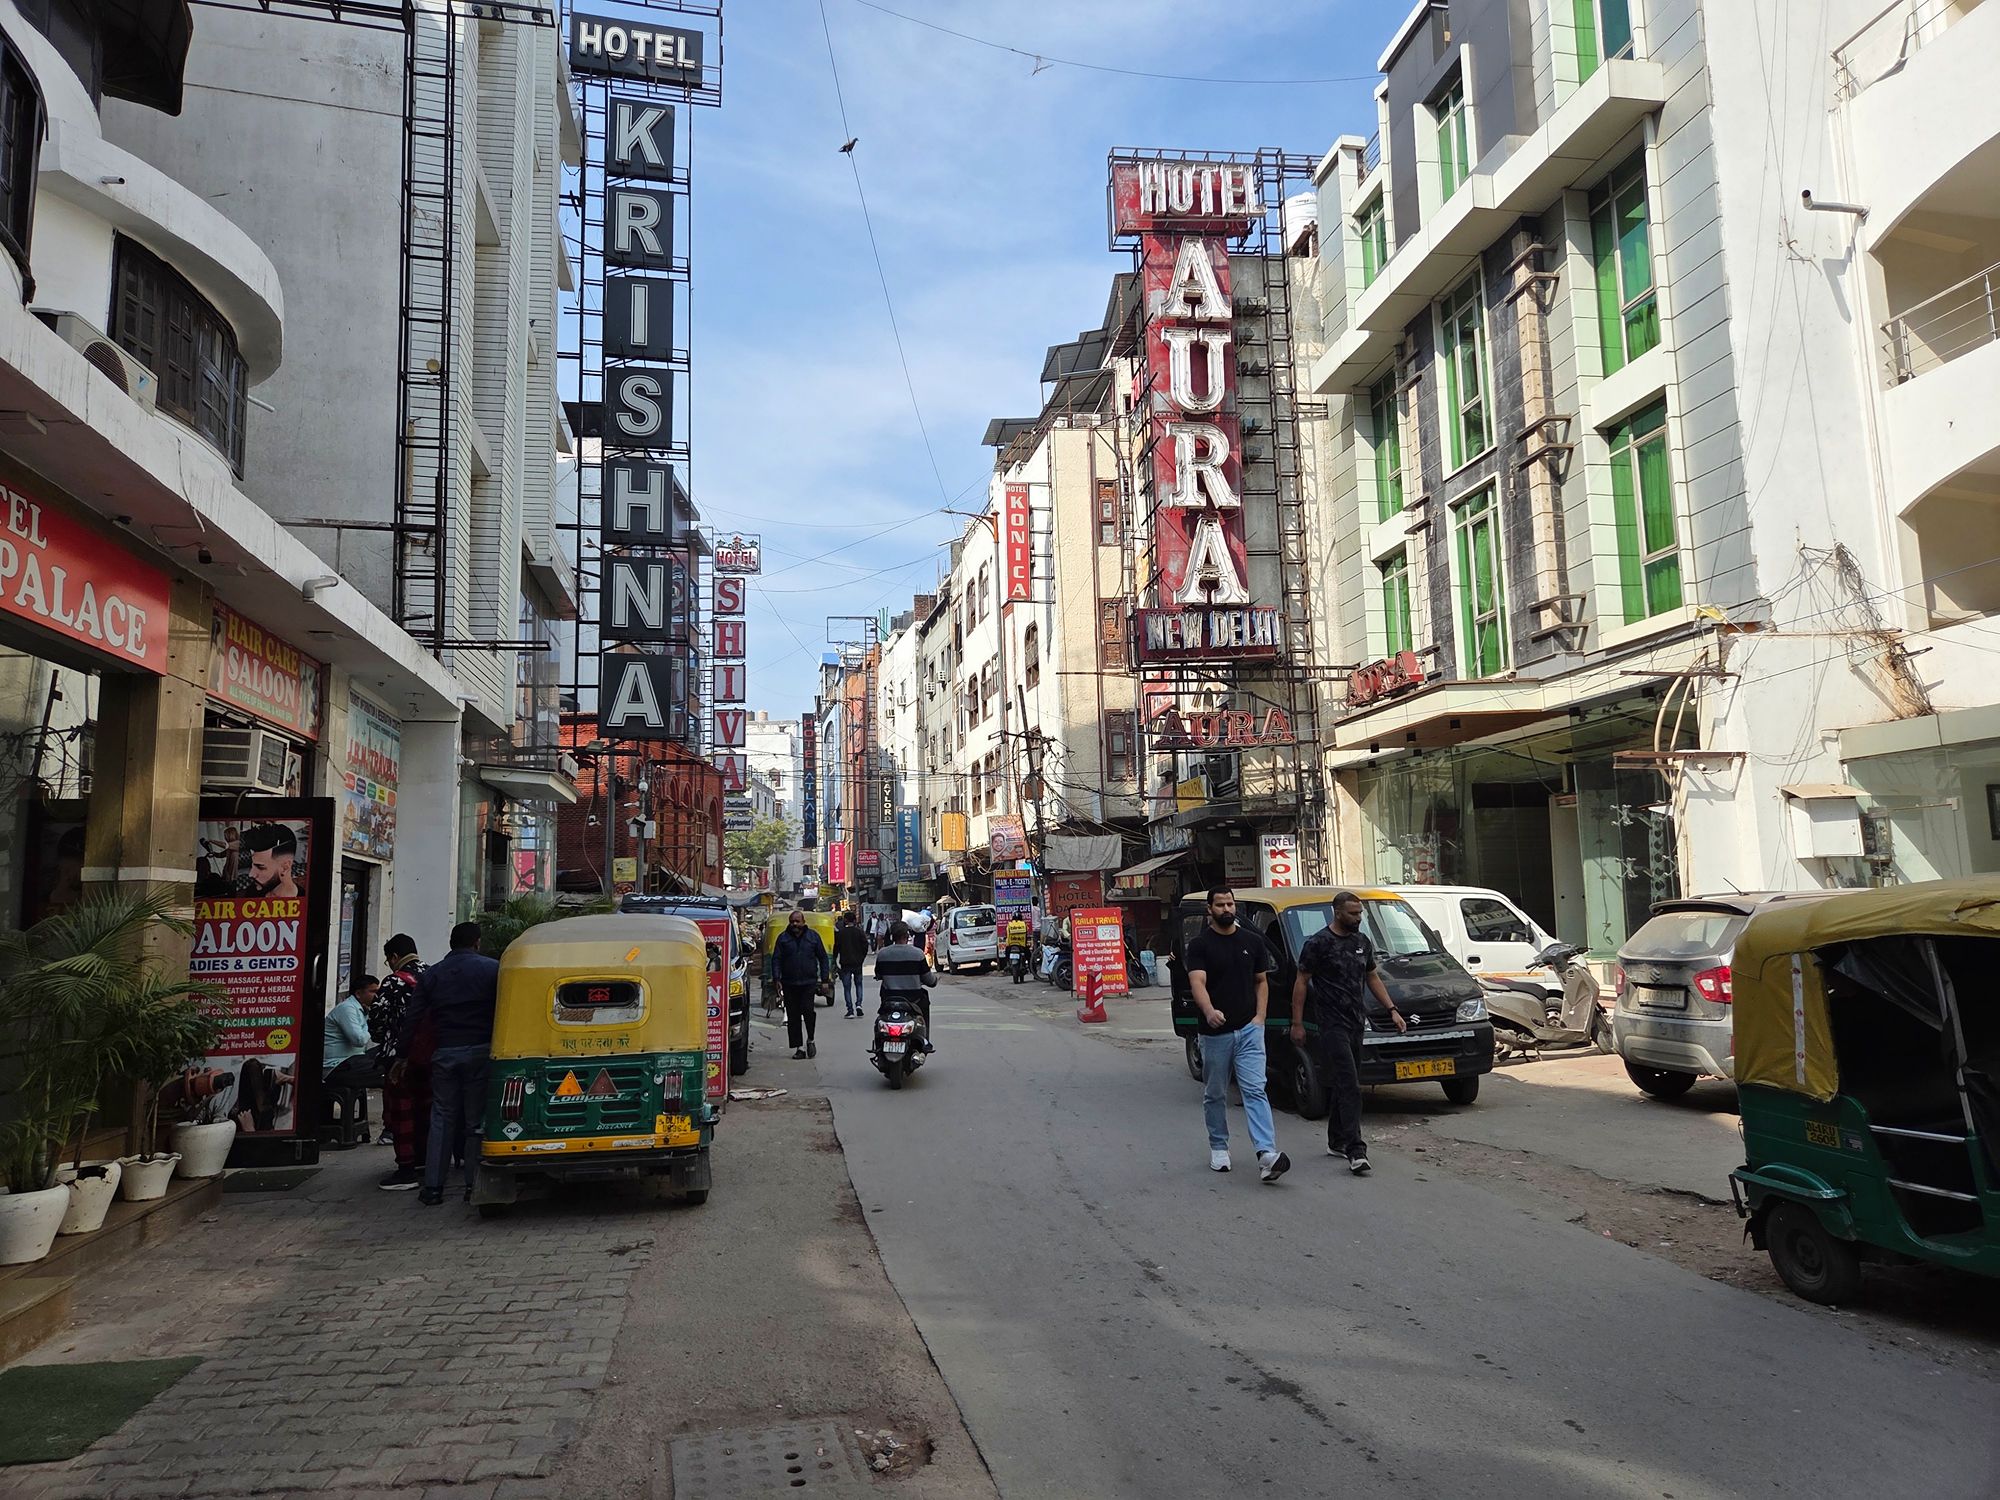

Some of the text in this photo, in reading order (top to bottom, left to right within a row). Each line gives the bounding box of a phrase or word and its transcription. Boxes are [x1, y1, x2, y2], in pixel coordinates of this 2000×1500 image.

[579, 21, 696, 70] HOTEL
[1139, 162, 1268, 218] HOTEL
[606, 104, 666, 728] KRISHNA
[1161, 235, 1251, 605] AURA
[1006, 484, 1027, 493] HOTEL
[1010, 495, 1027, 597] KONICA
[716, 549, 757, 566] HOTEL
[0, 538, 147, 659] PALACE
[1146, 608, 1282, 650] NEW DELHI
[227, 613, 300, 677] HAIR CARE
[227, 645, 297, 709] SALOON
[716, 578, 743, 791] SHIVA
[1156, 707, 1295, 748] AURA
[804, 719, 814, 769] HOTEL
[804, 772, 815, 841] ATLANTA
[1264, 837, 1294, 847] HOTEL
[1058, 891, 1094, 902] HOTEL
[195, 900, 301, 919] AIR CARE
[1095, 916, 1119, 925] TRAVEL
[192, 920, 300, 954] ALOON
[190, 957, 295, 971] ADIES & GENTS
[227, 976, 263, 984] MASSAGE,
[264, 975, 281, 983] HAIR
[282, 975, 297, 983] CUT
[260, 986, 266, 994] &
[267, 985, 295, 993] HERBAL
[257, 996, 291, 1004] MASSAGE
[248, 1006, 277, 1014] WAXING
[250, 1018, 256, 1026] &
[258, 1017, 276, 1026] HAIR
[277, 1016, 291, 1025] SPA
[241, 1031, 255, 1039] Road
[1402, 1065, 1413, 1077] DL
[506, 1126, 519, 1134] CNG
[596, 1123, 634, 1131] DISTANCE
